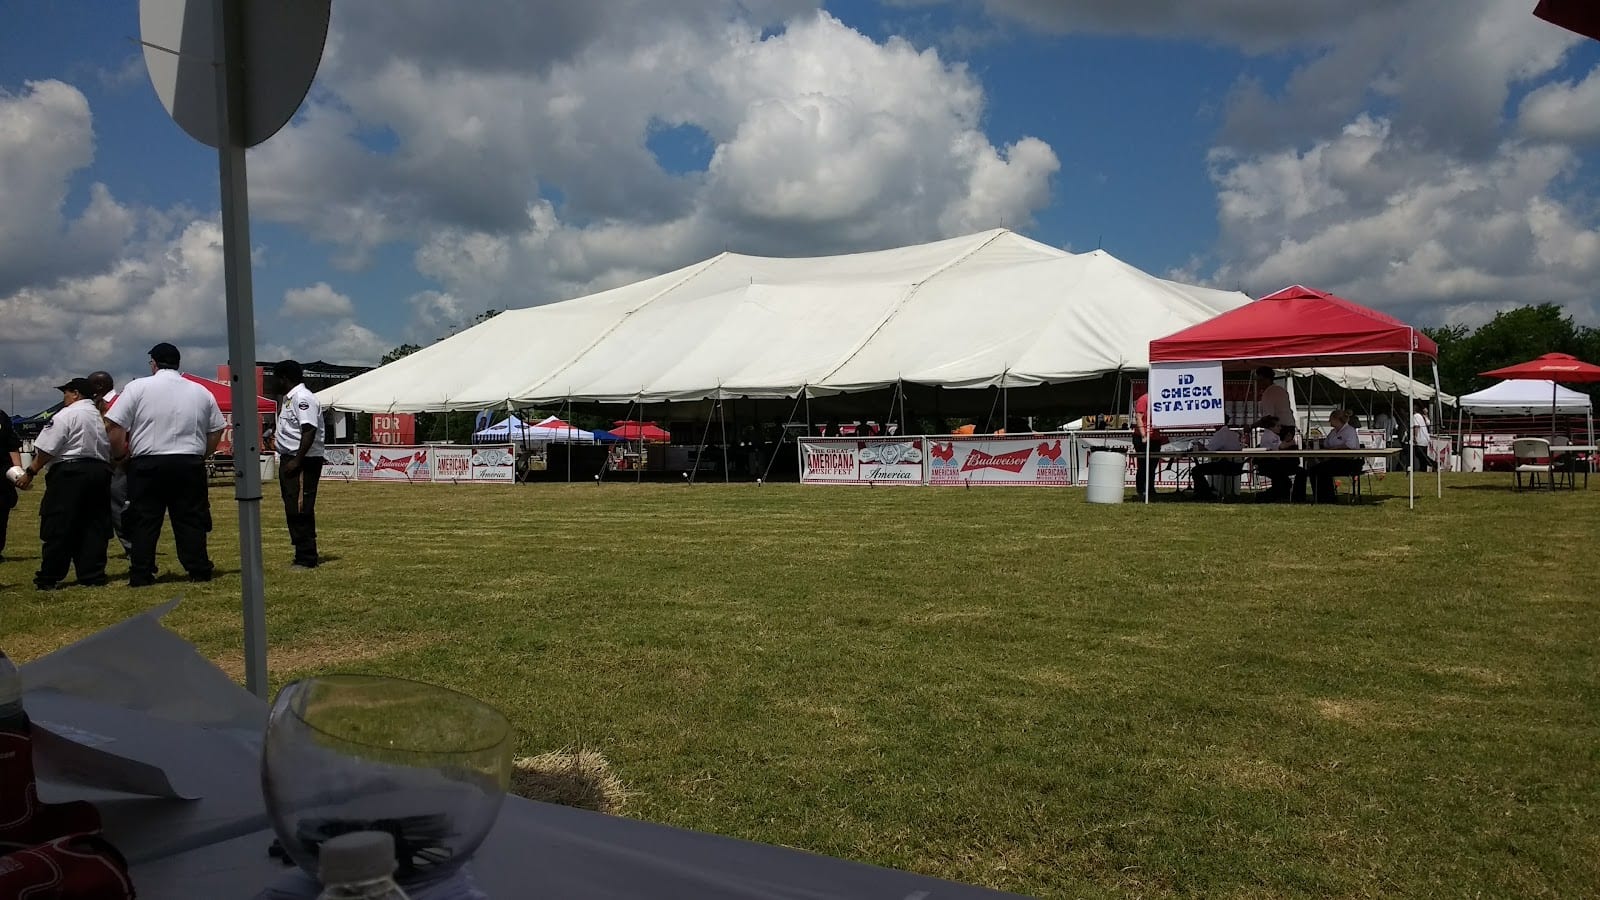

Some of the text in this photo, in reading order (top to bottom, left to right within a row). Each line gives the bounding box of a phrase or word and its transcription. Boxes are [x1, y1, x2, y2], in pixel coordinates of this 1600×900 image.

[1161, 386, 1212, 399] CHECK
[1153, 398, 1222, 412] STATION
[374, 416, 400, 430] FOR
[373, 432, 404, 445] YOU.
[376, 458, 410, 468] Budweiser
[437, 458, 470, 471] AMERICANA
[807, 453, 854, 469] AMERICANA
[966, 453, 1027, 466] Budweiser
[478, 468, 506, 478] America
[864, 467, 912, 479] America
[931, 468, 960, 476] AMERICANA
[1036, 468, 1068, 477] AMERICANA
